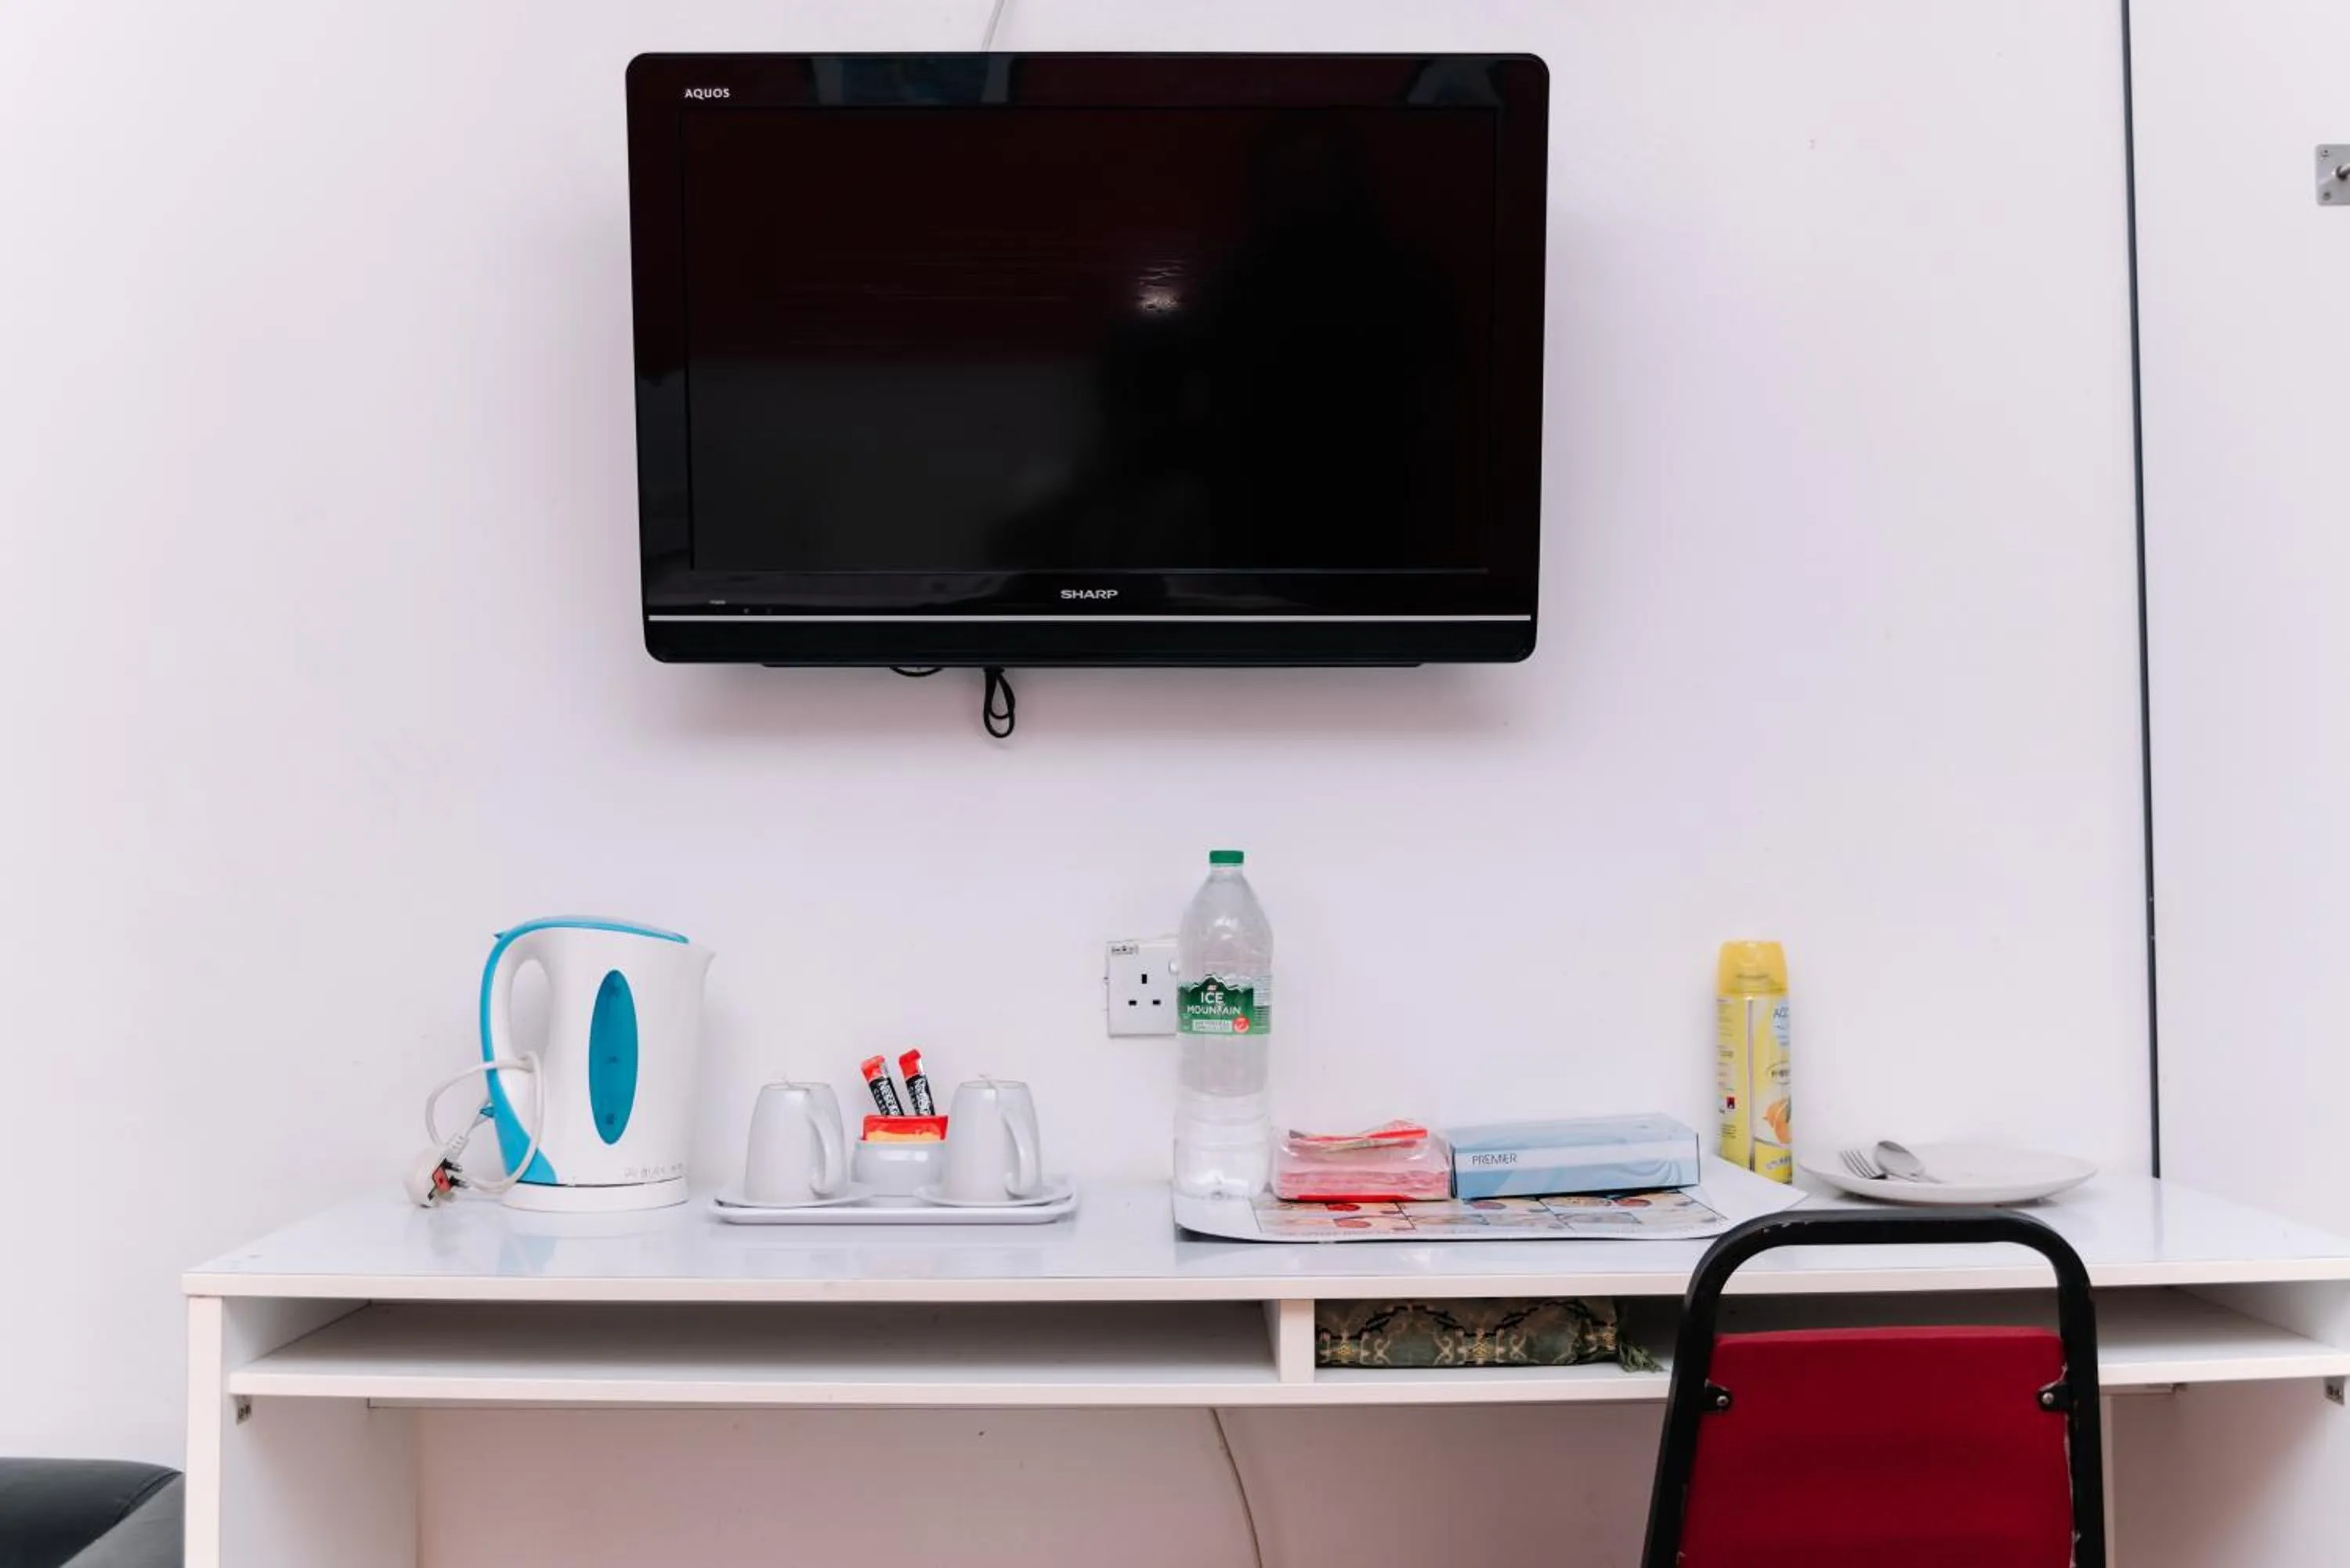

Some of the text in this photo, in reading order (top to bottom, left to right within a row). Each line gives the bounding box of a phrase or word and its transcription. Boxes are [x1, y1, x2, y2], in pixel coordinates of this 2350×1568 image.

[684, 89, 730, 100] AQUOS
[1060, 589, 1119, 599] SHARP
[1201, 992, 1225, 1004] ICE
[1186, 1004, 1242, 1015] MOUNTAIN
[1472, 1152, 1518, 1165] PREMIER
